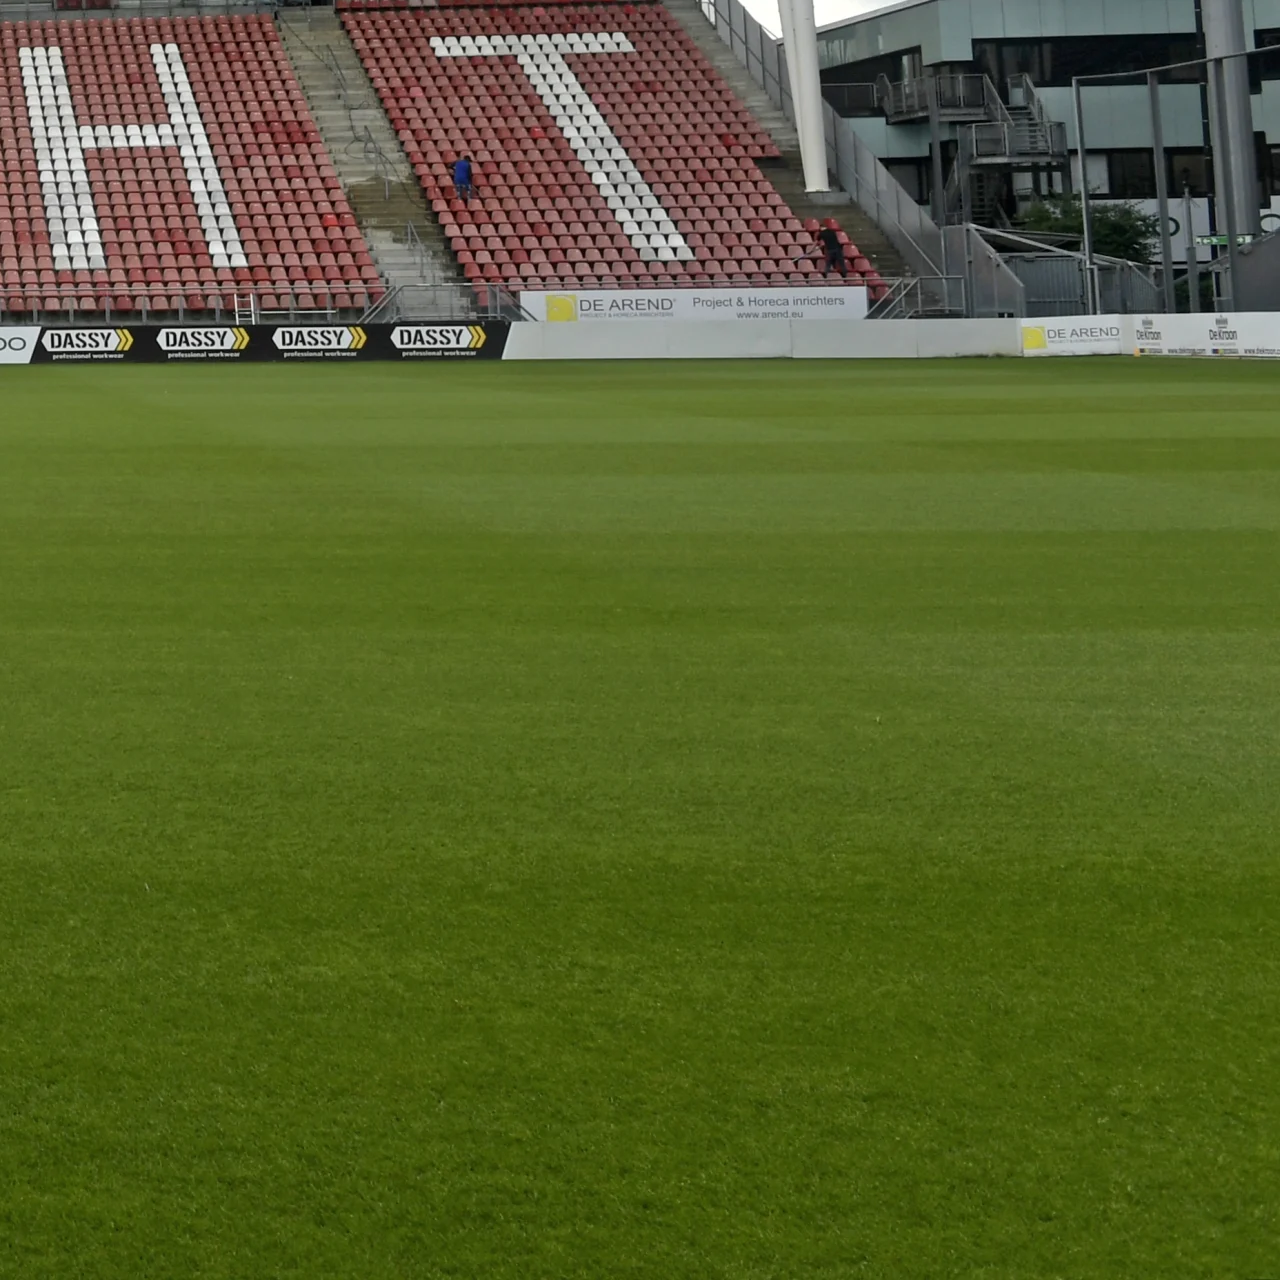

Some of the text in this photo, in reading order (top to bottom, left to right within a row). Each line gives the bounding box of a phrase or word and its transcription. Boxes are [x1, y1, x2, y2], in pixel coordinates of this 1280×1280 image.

[580, 299, 604, 312] DE
[693, 296, 845, 309] Project & Horeca inrichters
[736, 310, 804, 319] www.arend.eu
[281, 330, 344, 346] DASSY
[399, 329, 464, 346] DASSY
[1047, 327, 1119, 338] DE AREND
[50, 332, 112, 348] DASSY
[165, 331, 228, 347] DASSY
[52, 352, 90, 360] professional
[168, 351, 206, 359] professional
[284, 350, 322, 358] professional
[402, 349, 442, 357] professional
